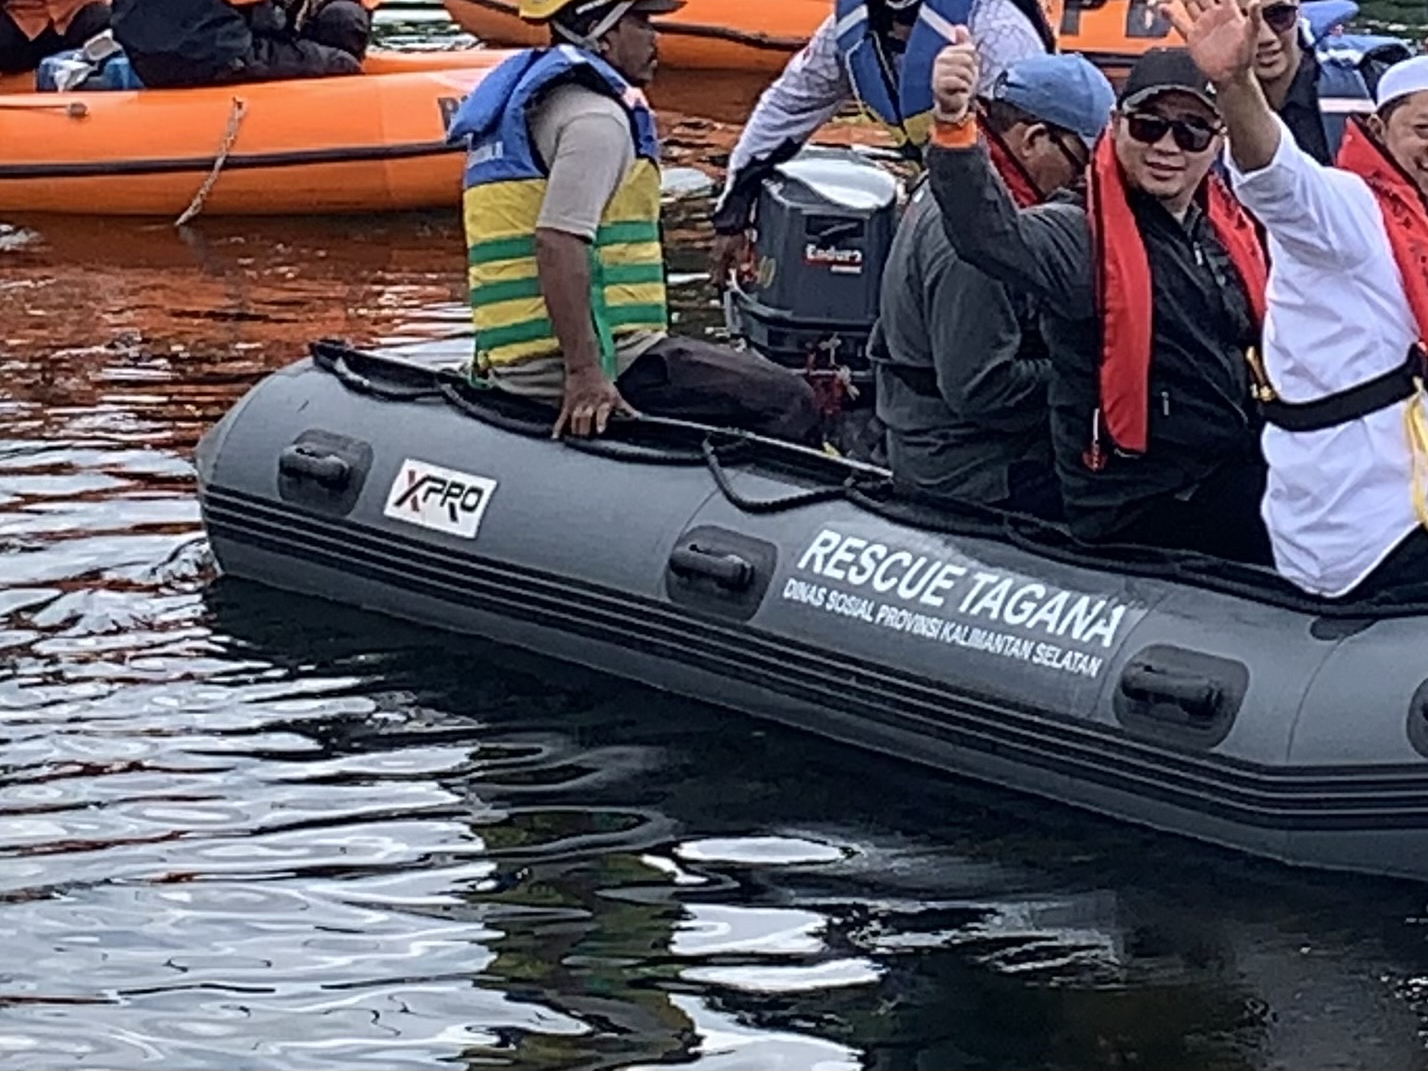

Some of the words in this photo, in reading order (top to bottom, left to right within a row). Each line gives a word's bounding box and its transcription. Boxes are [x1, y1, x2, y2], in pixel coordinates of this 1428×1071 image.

[394, 470, 484, 523] XPRO
[783, 578, 827, 607] DINAS
[825, 590, 875, 623] SOSIAL
[875, 604, 944, 639] PROVINSI
[941, 621, 1035, 660] KALIMANTAN
[1032, 642, 1103, 678] SELATAN
[797, 529, 967, 607] RESCUE
[959, 572, 1126, 647] TAGANA
